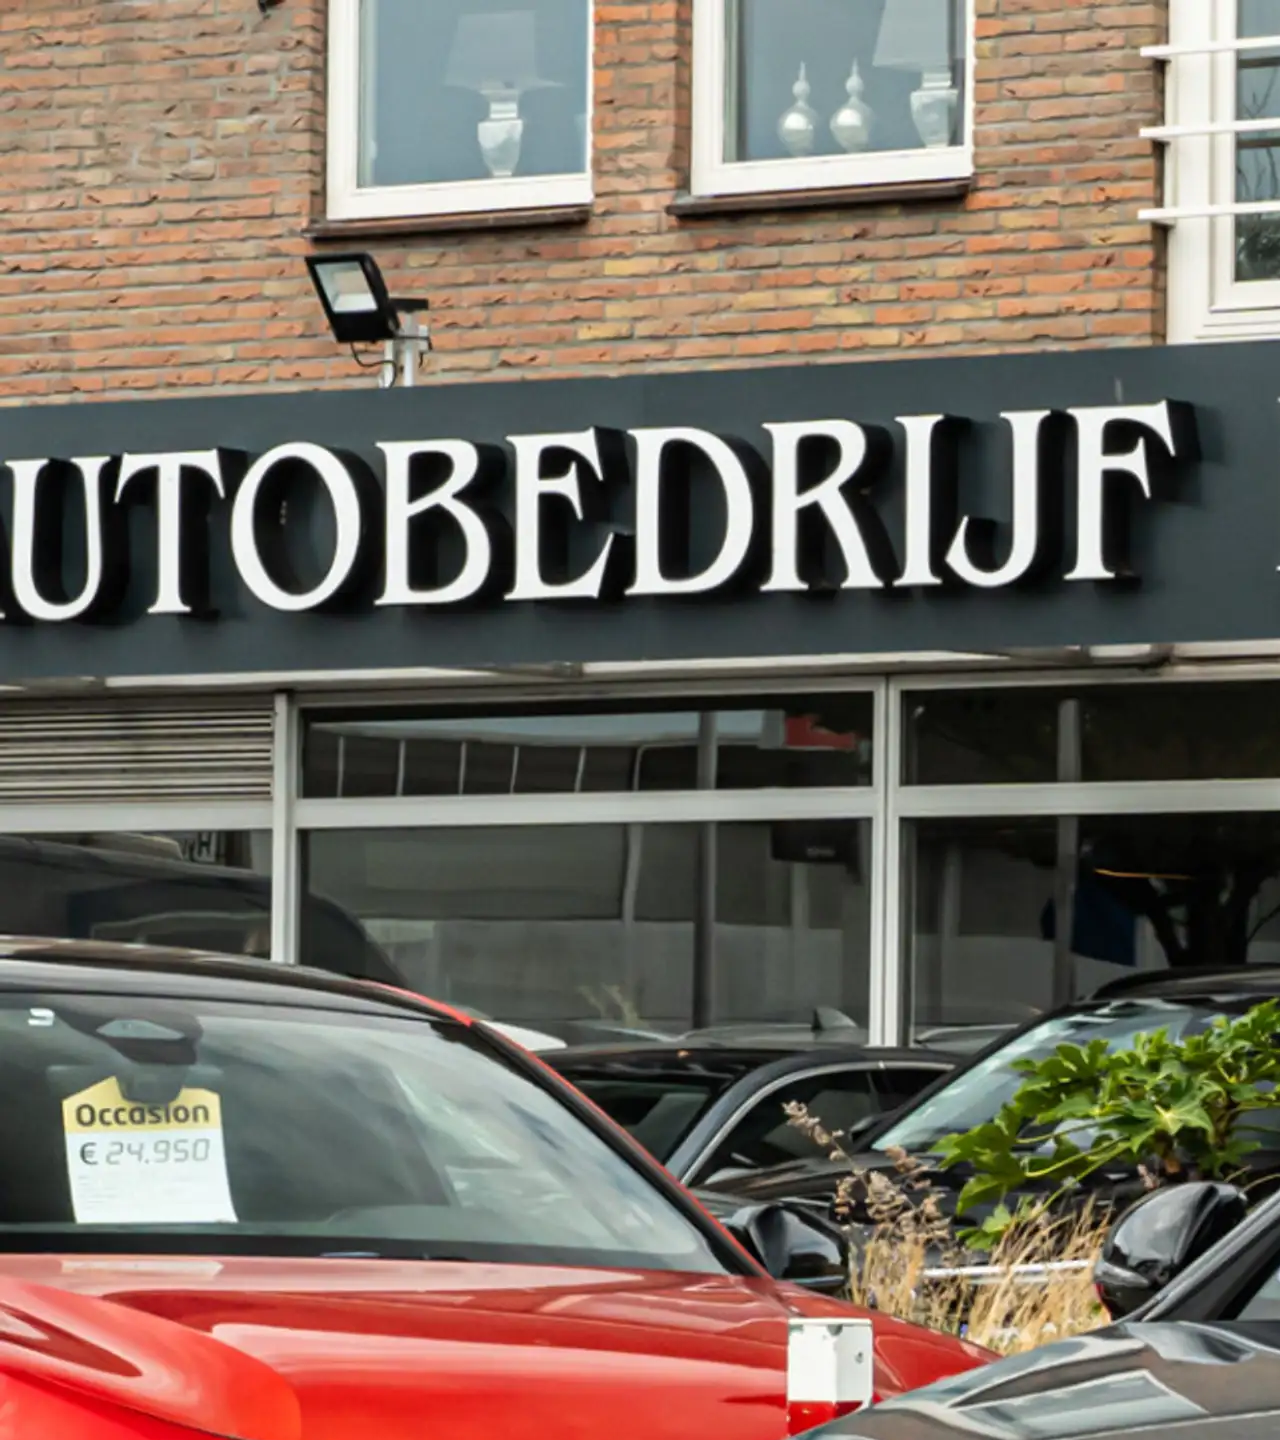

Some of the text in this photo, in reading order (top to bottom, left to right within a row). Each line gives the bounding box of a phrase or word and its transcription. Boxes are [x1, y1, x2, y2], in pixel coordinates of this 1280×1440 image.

[0, 398, 1178, 622] UTOBEDRIJF
[75, 1103, 210, 1127] Occasion
[105, 1138, 211, 1165] 24.950
